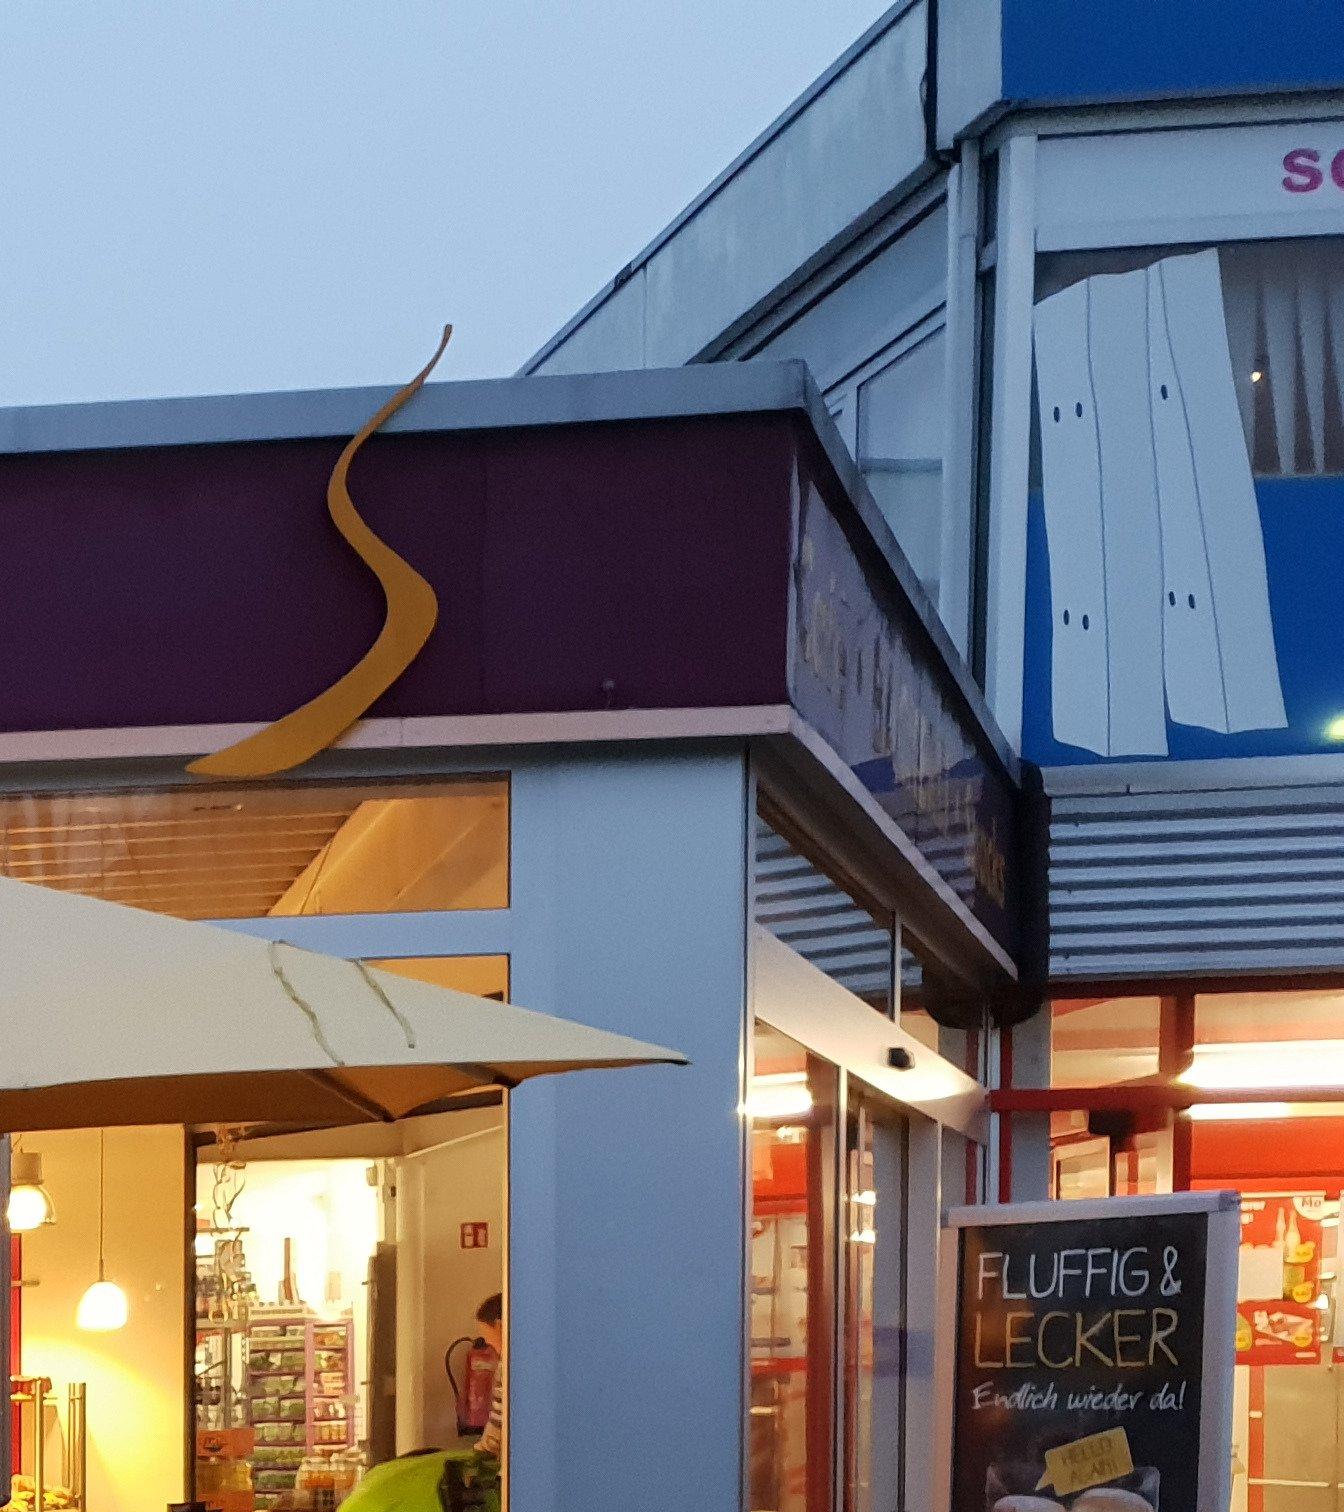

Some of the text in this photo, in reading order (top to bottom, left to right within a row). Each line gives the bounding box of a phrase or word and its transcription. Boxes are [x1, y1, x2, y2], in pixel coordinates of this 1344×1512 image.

[977, 1245, 1182, 1300] FLUFFIG &
[973, 1307, 1179, 1369] LECKER
[970, 1379, 1187, 1412] Endlich wieder da!
